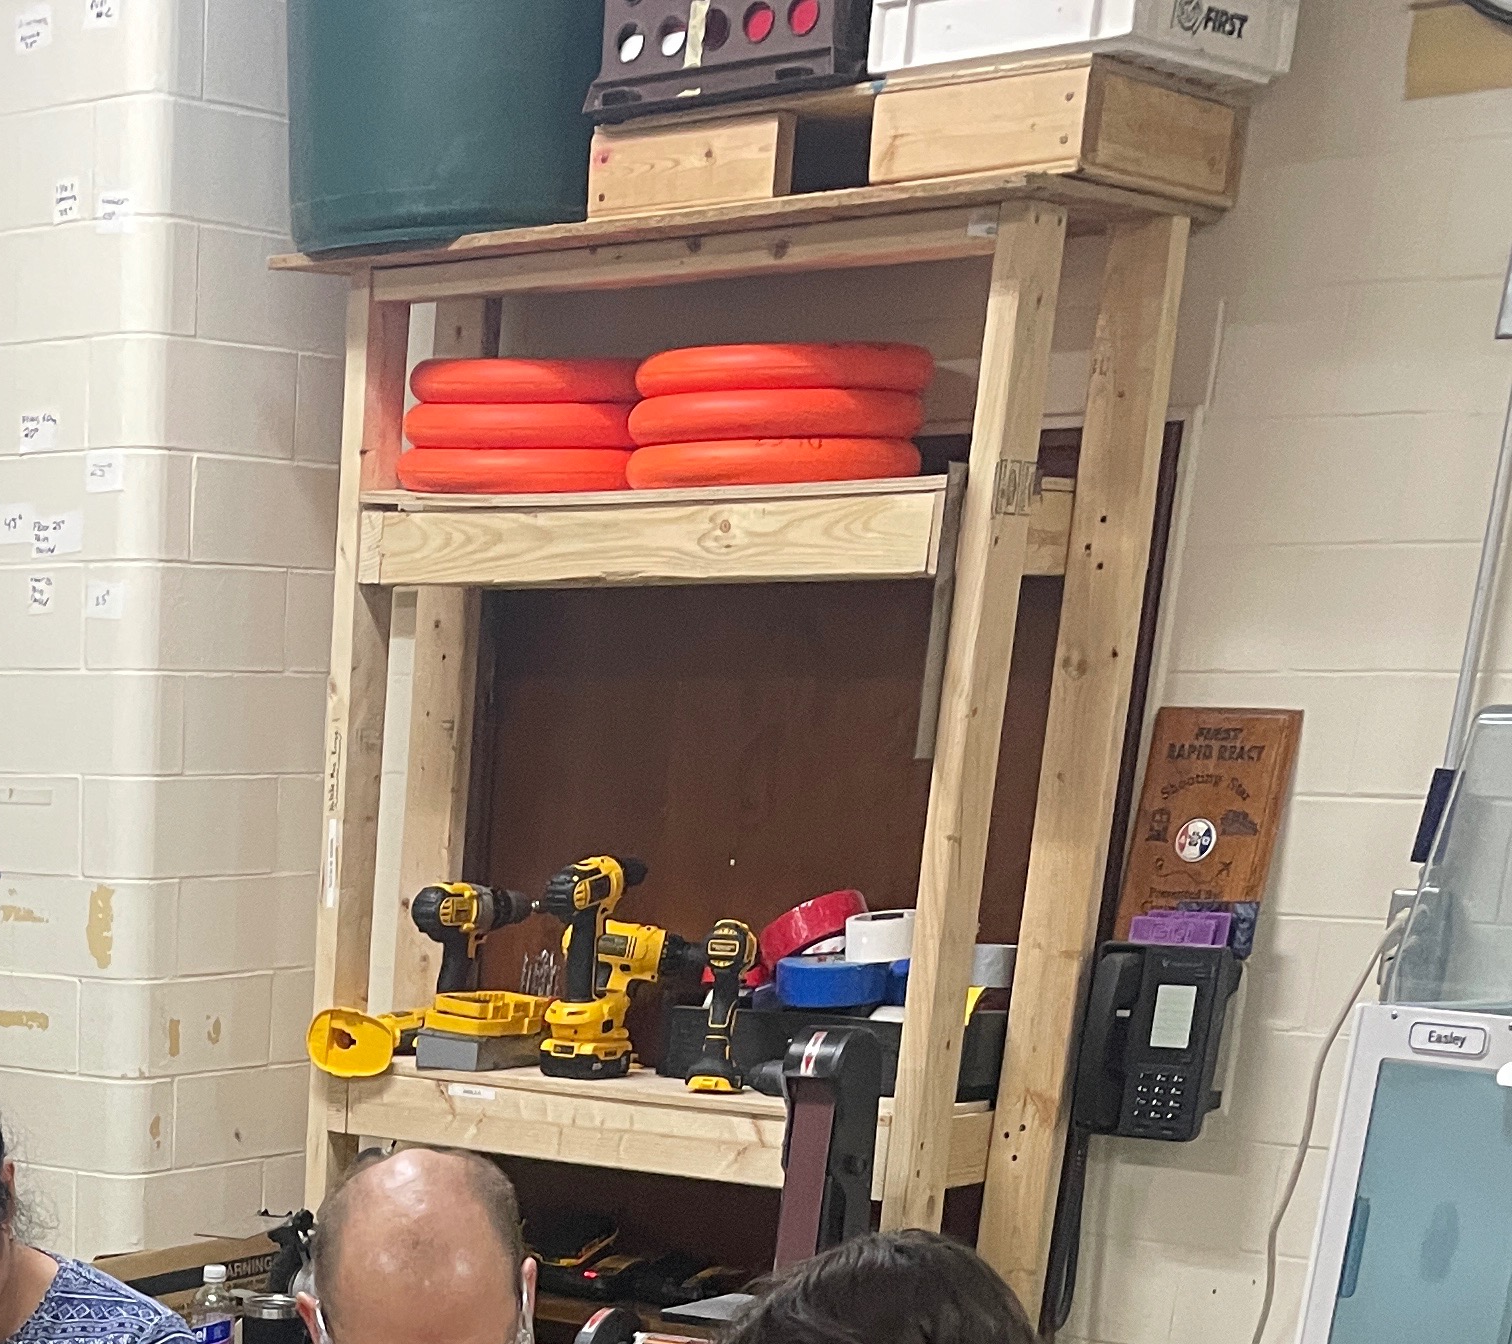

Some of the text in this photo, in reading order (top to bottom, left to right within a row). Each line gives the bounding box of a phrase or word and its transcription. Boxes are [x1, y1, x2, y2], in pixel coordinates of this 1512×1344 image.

[1203, 6, 1248, 39] FIRST
[1428, 1029, 1467, 1049] Easley
[225, 1255, 273, 1278] ARNING
